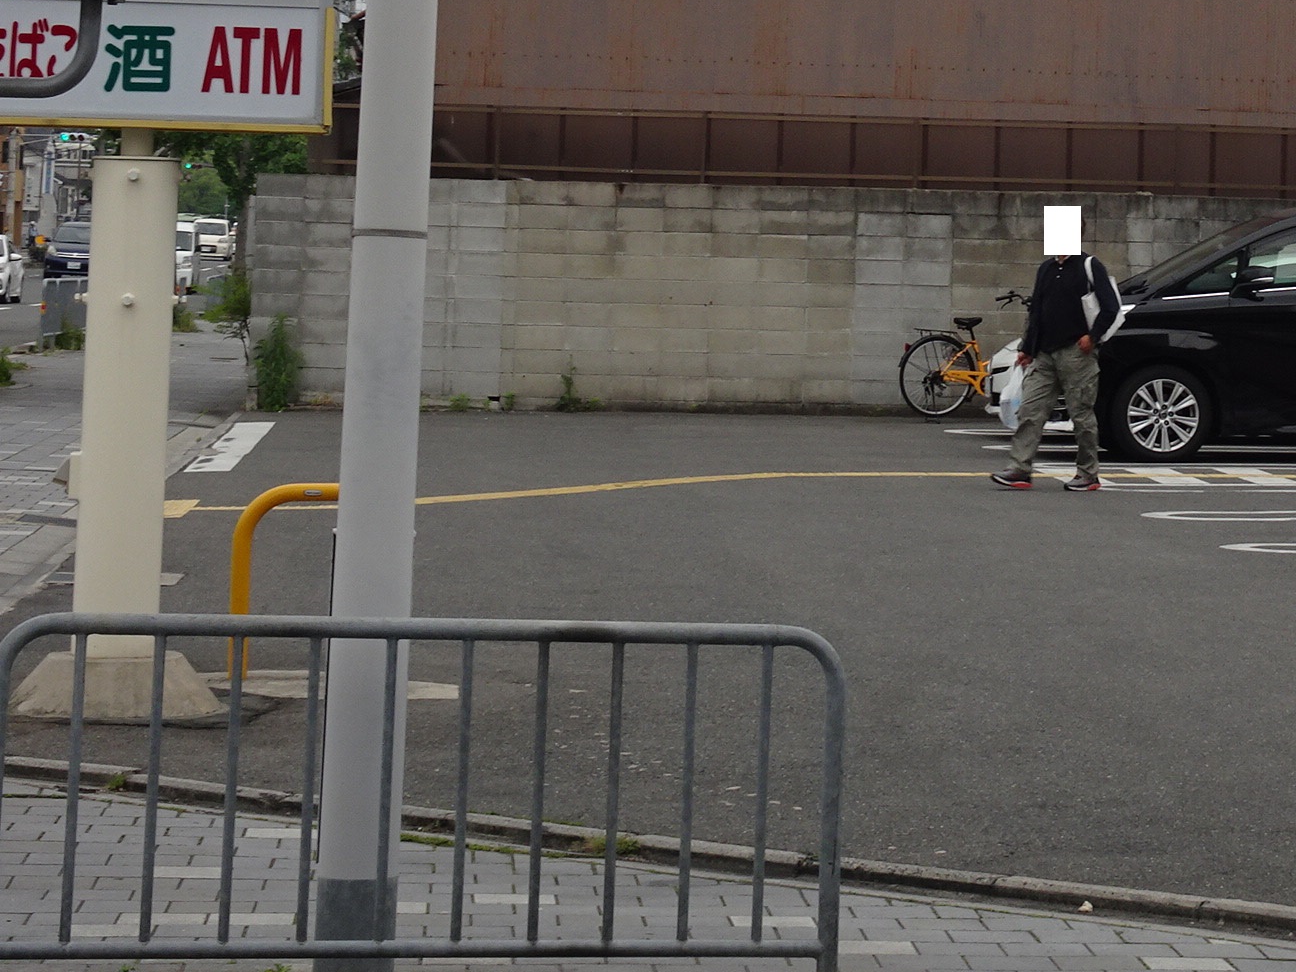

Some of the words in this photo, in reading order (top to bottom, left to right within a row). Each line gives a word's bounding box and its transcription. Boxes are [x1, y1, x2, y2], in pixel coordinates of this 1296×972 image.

[0, 18, 78, 78] ばこ
[104, 23, 175, 93] 酒
[201, 25, 303, 96] ATM
